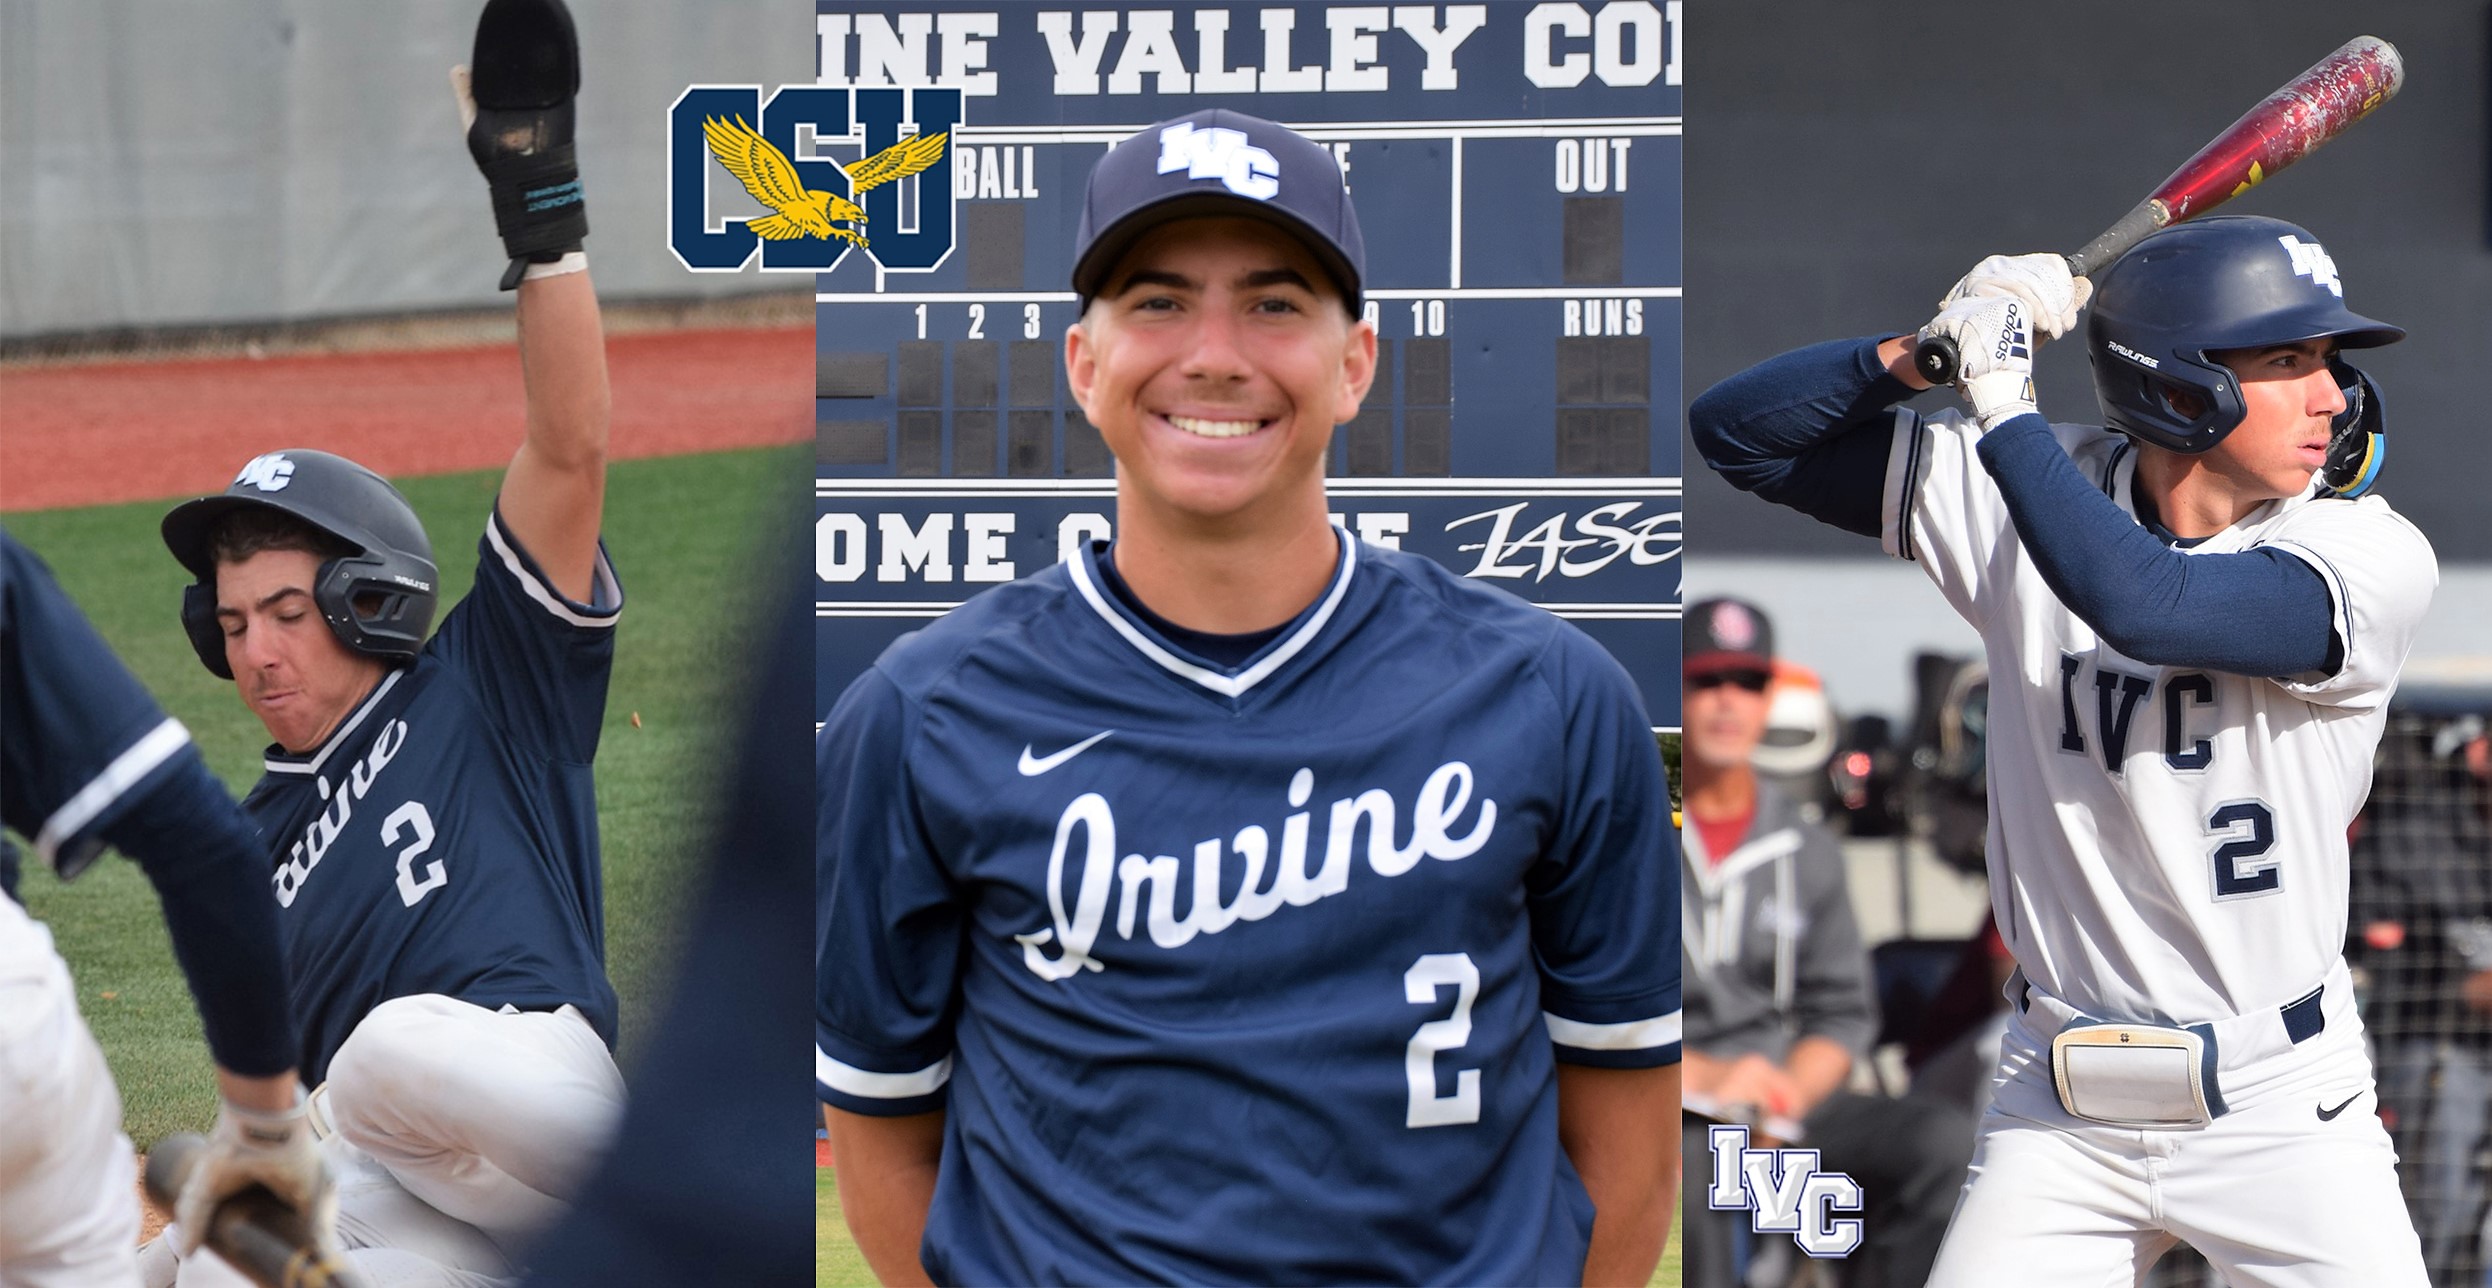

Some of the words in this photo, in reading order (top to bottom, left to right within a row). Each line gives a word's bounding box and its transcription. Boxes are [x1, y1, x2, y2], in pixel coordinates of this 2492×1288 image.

[817, 13, 998, 96] INE
[1037, 5, 1486, 95] VALLEY
[1524, 1, 1682, 88] CO
[955, 146, 1038, 199] BALL
[1158, 122, 1279, 201] IVC
[1555, 139, 1631, 193] OUT
[914, 305, 926, 339] 1
[968, 305, 985, 339] 2
[1024, 304, 1040, 339] 3
[1411, 300, 1445, 336] 10
[1564, 299, 1643, 337] RUNS
[1995, 303, 2017, 361] adidas
[2107, 340, 2159, 369] RAWLINGS
[815, 513, 1015, 582] OME
[2058, 651, 2219, 779] IVC
[380, 800, 447, 907] 2
[1014, 761, 1497, 981] Irvine
[2204, 797, 2284, 902] 2
[1404, 953, 1481, 1128] 2
